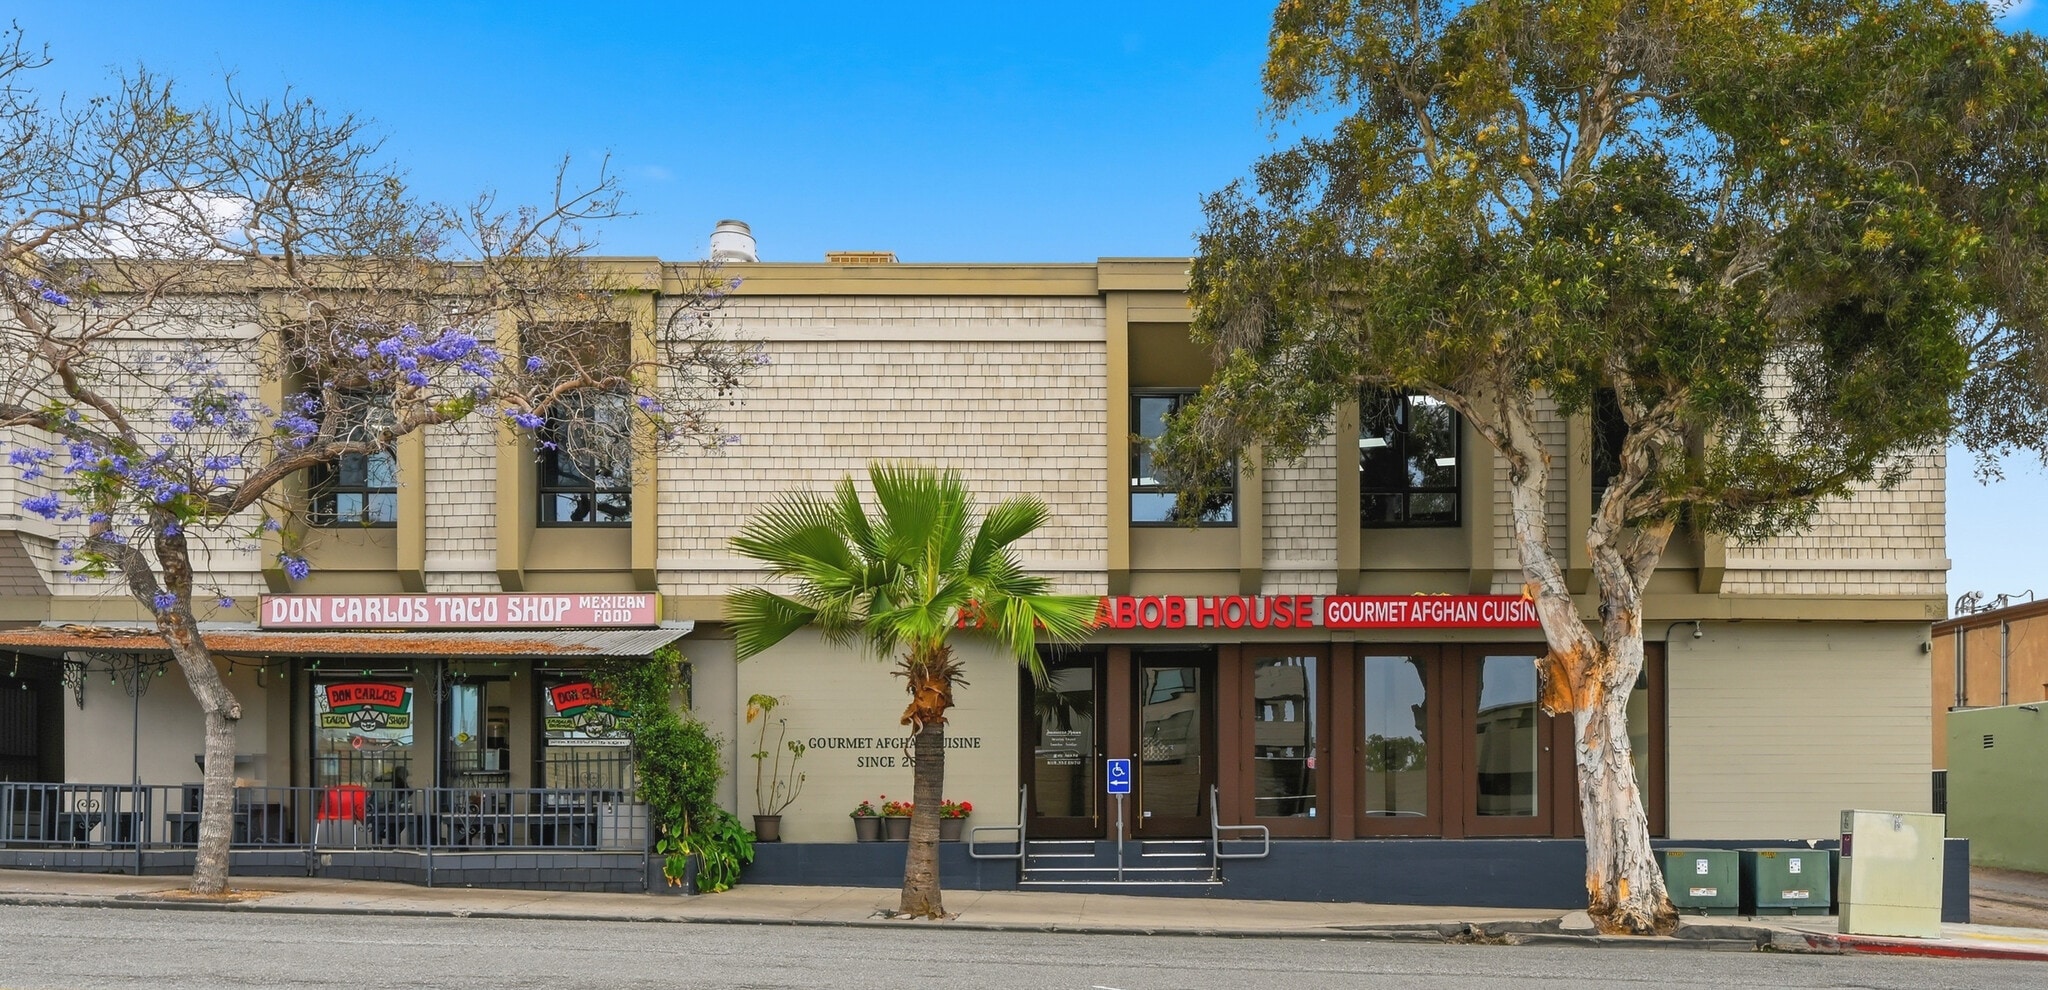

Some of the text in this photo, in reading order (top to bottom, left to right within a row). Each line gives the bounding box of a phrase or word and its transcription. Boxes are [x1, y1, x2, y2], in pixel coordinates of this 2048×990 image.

[579, 596, 645, 608] MEXICAN
[272, 597, 571, 622] DON CARLOS TACO SHOP
[1088, 595, 1187, 629] ABOB
[1197, 595, 1313, 629] HOUSE
[1328, 601, 1539, 622] GOURMET AFGHAN CUISIN
[594, 610, 632, 622] FOOD
[332, 688, 397, 702] DON CARLOS
[324, 716, 406, 725] TACO SHOP
[808, 737, 873, 749] GOURMET
[875, 737, 916, 749] AFGHA
[857, 757, 895, 768] SINCE
